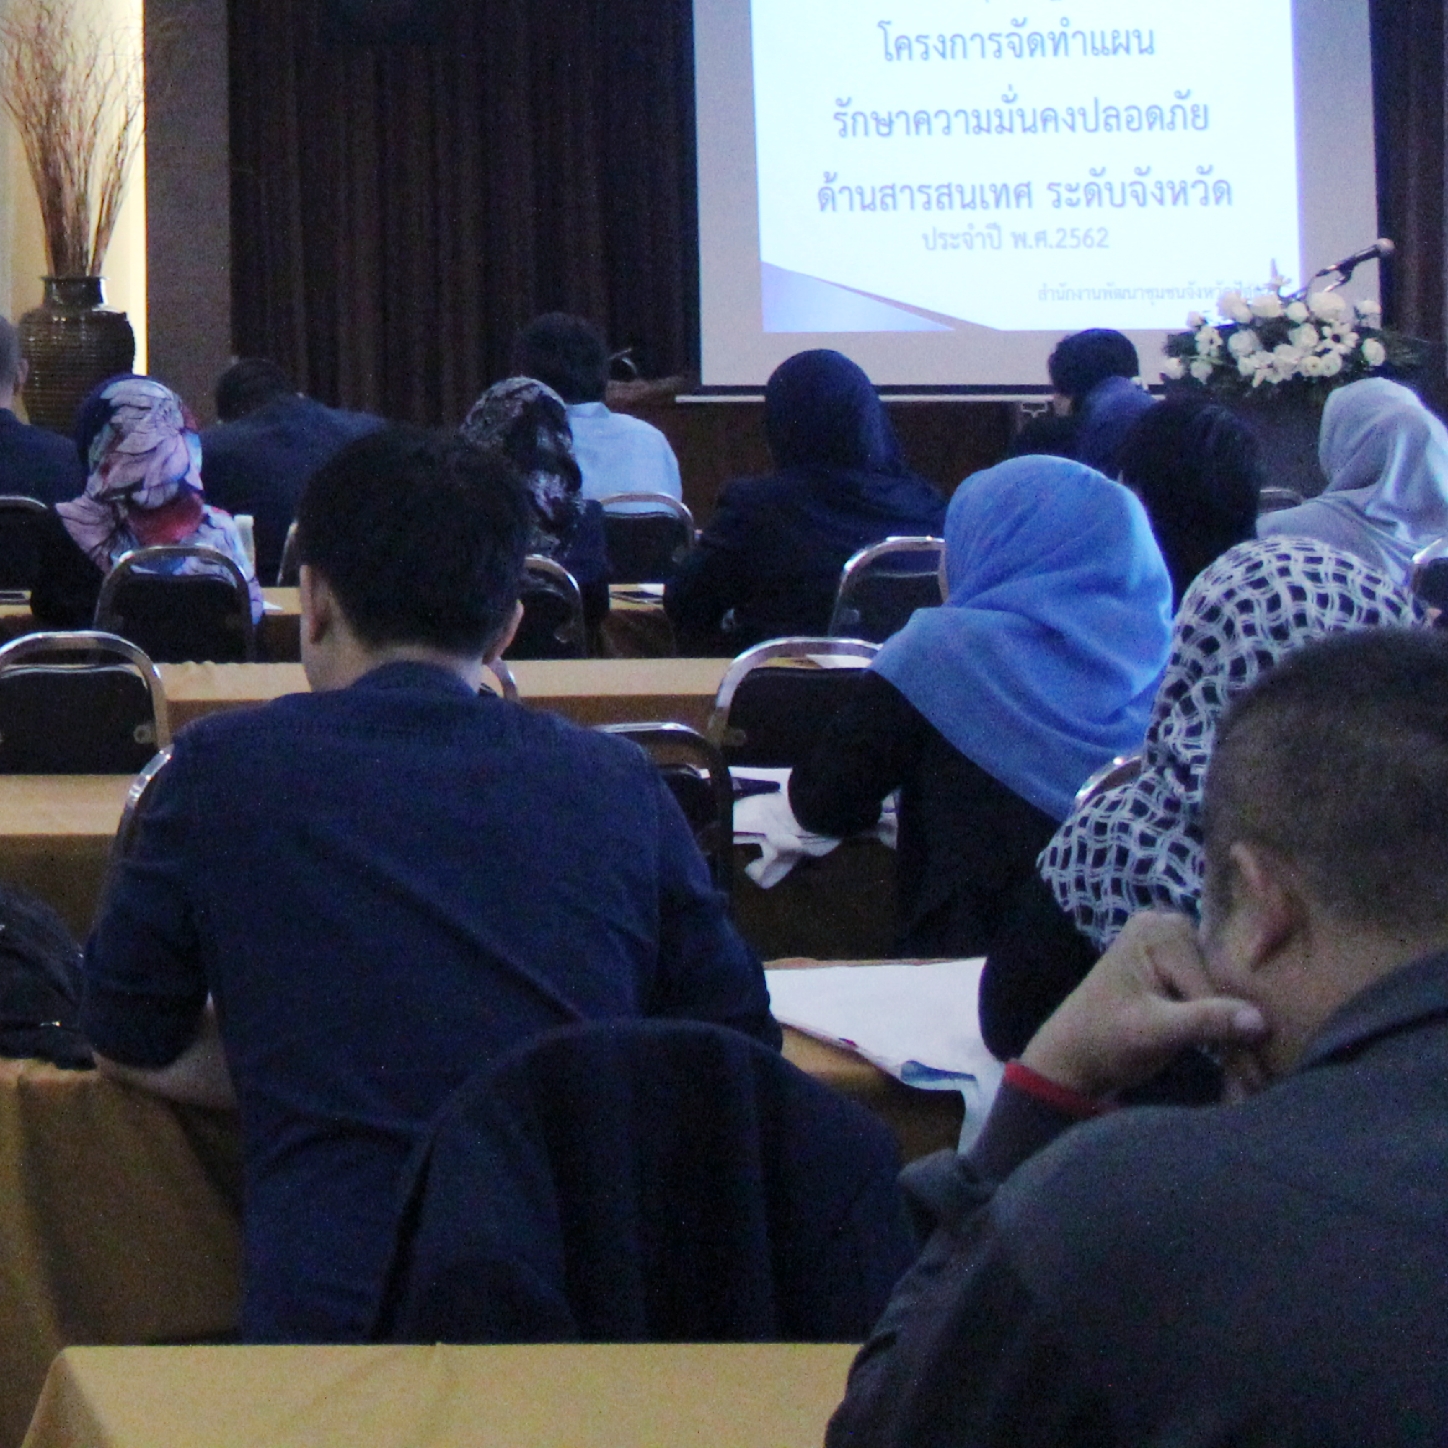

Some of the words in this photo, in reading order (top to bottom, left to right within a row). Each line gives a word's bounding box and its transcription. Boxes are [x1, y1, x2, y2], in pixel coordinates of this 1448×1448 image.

[877, 16, 1156, 63] โครงการจัดทำแผน
[833, 84, 1210, 139] รักษาความมั่นคงปลอดภัย
[817, 171, 1034, 213] ด้านสารสนเทศ
[1047, 164, 1233, 209] ระดับจังหวัด
[921, 222, 1004, 251] ประจำปี
[1010, 226, 1110, 250] พ.ศ.2562
